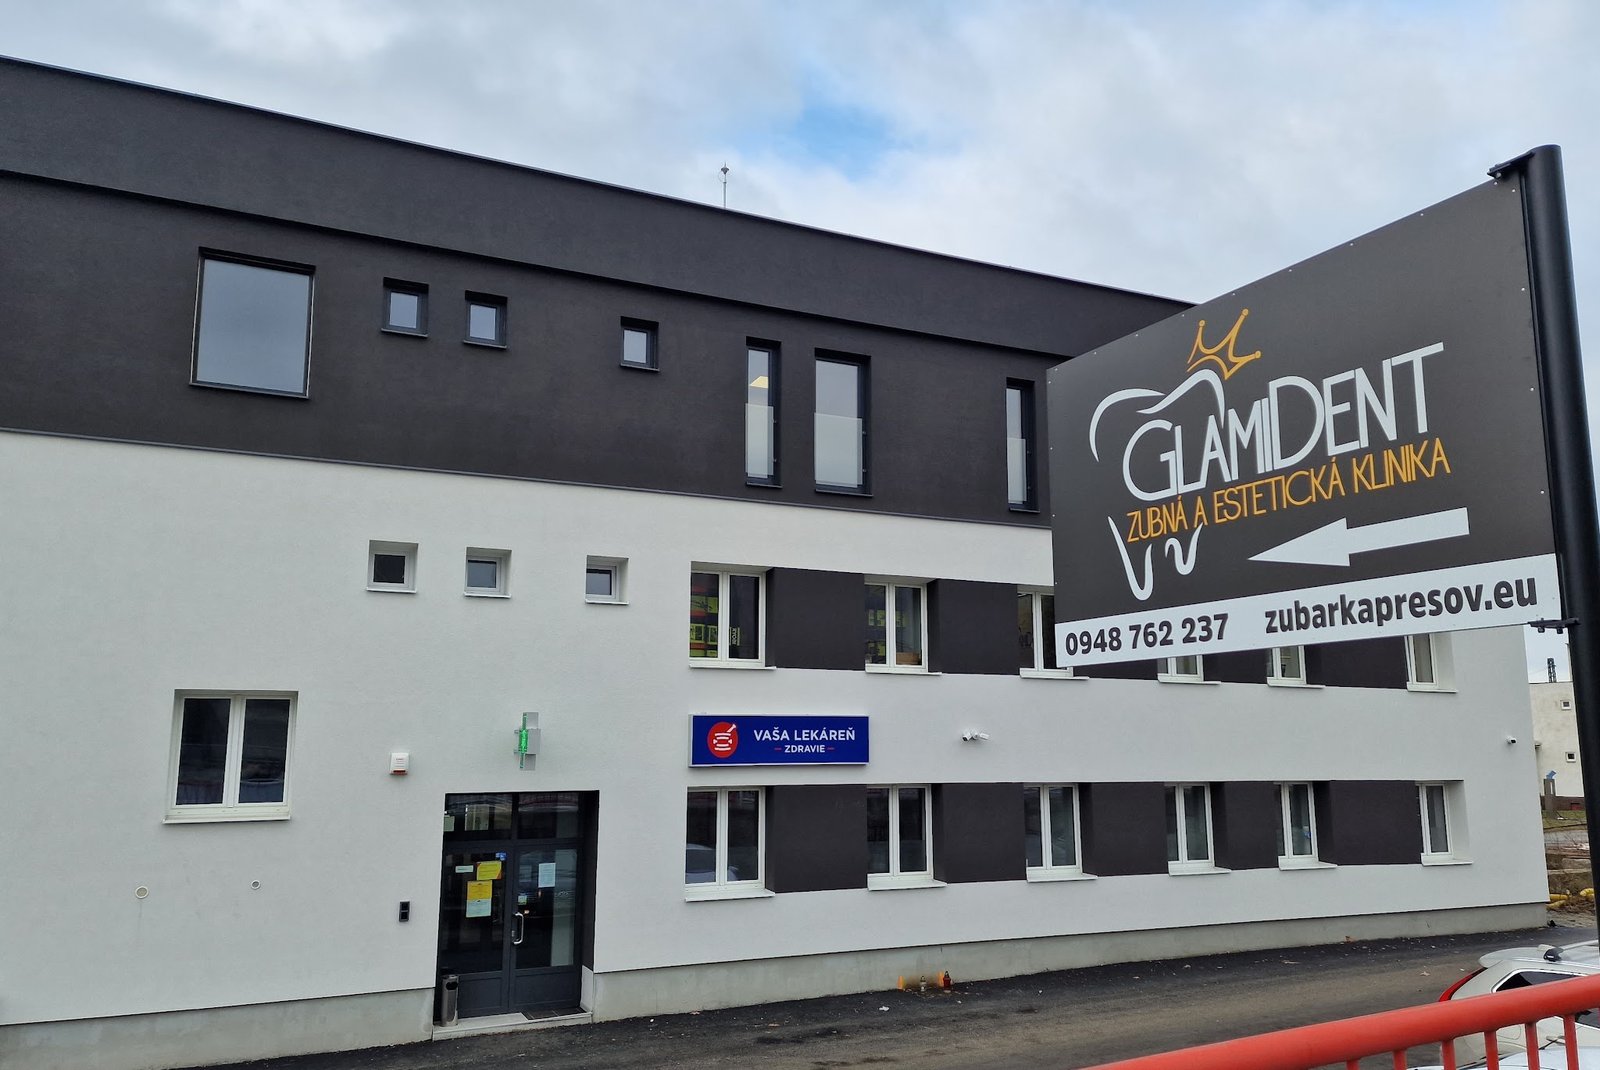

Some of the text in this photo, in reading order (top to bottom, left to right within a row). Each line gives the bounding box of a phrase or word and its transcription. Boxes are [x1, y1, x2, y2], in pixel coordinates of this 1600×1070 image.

[1122, 342, 1444, 501] GLAMIDENT
[1126, 437, 1451, 543] ZUBNÁ A ESTETICKÁ KLINIKA
[1265, 576, 1538, 635] zubarkapresov.eu
[1065, 613, 1230, 657] 0948 762 237
[753, 727, 855, 741] VAŠA LEKÁREŇ
[784, 745, 826, 753] ZDRAVIE
